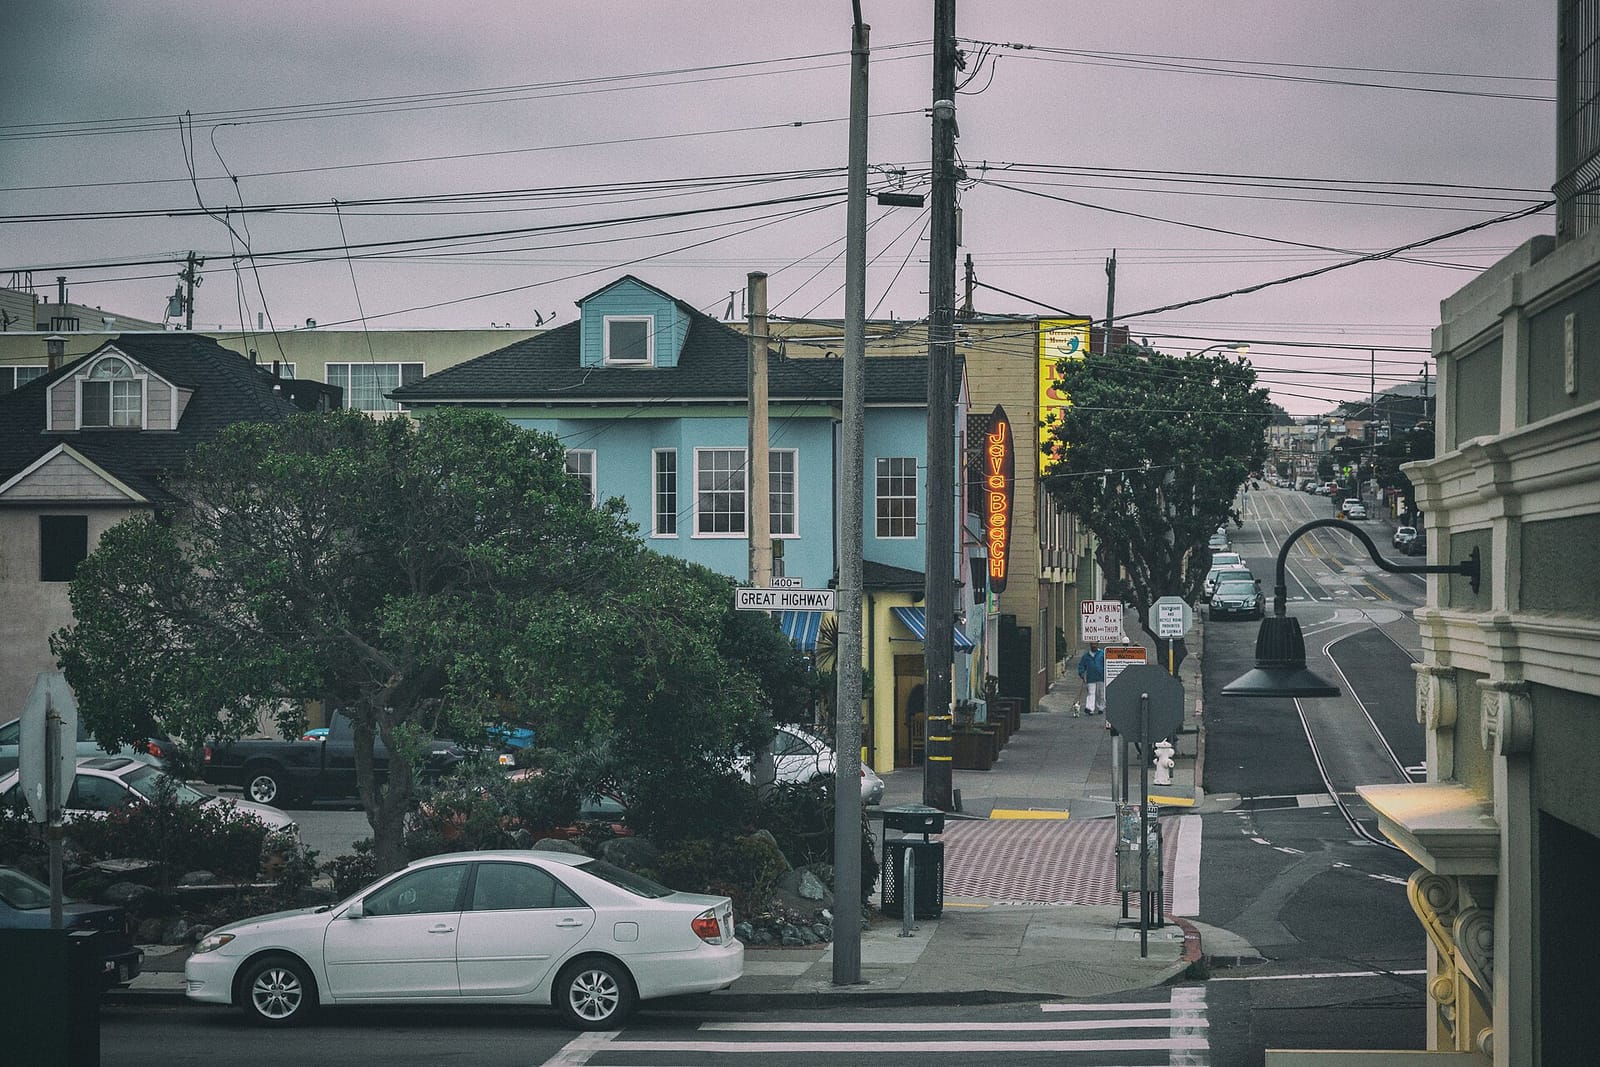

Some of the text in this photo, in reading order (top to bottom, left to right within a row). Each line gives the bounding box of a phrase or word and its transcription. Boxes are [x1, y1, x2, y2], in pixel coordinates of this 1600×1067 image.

[771, 578, 792, 587] 1400
[741, 592, 830, 606] GREAT HIGHWAY
[1082, 602, 1121, 614] NO PARKING
